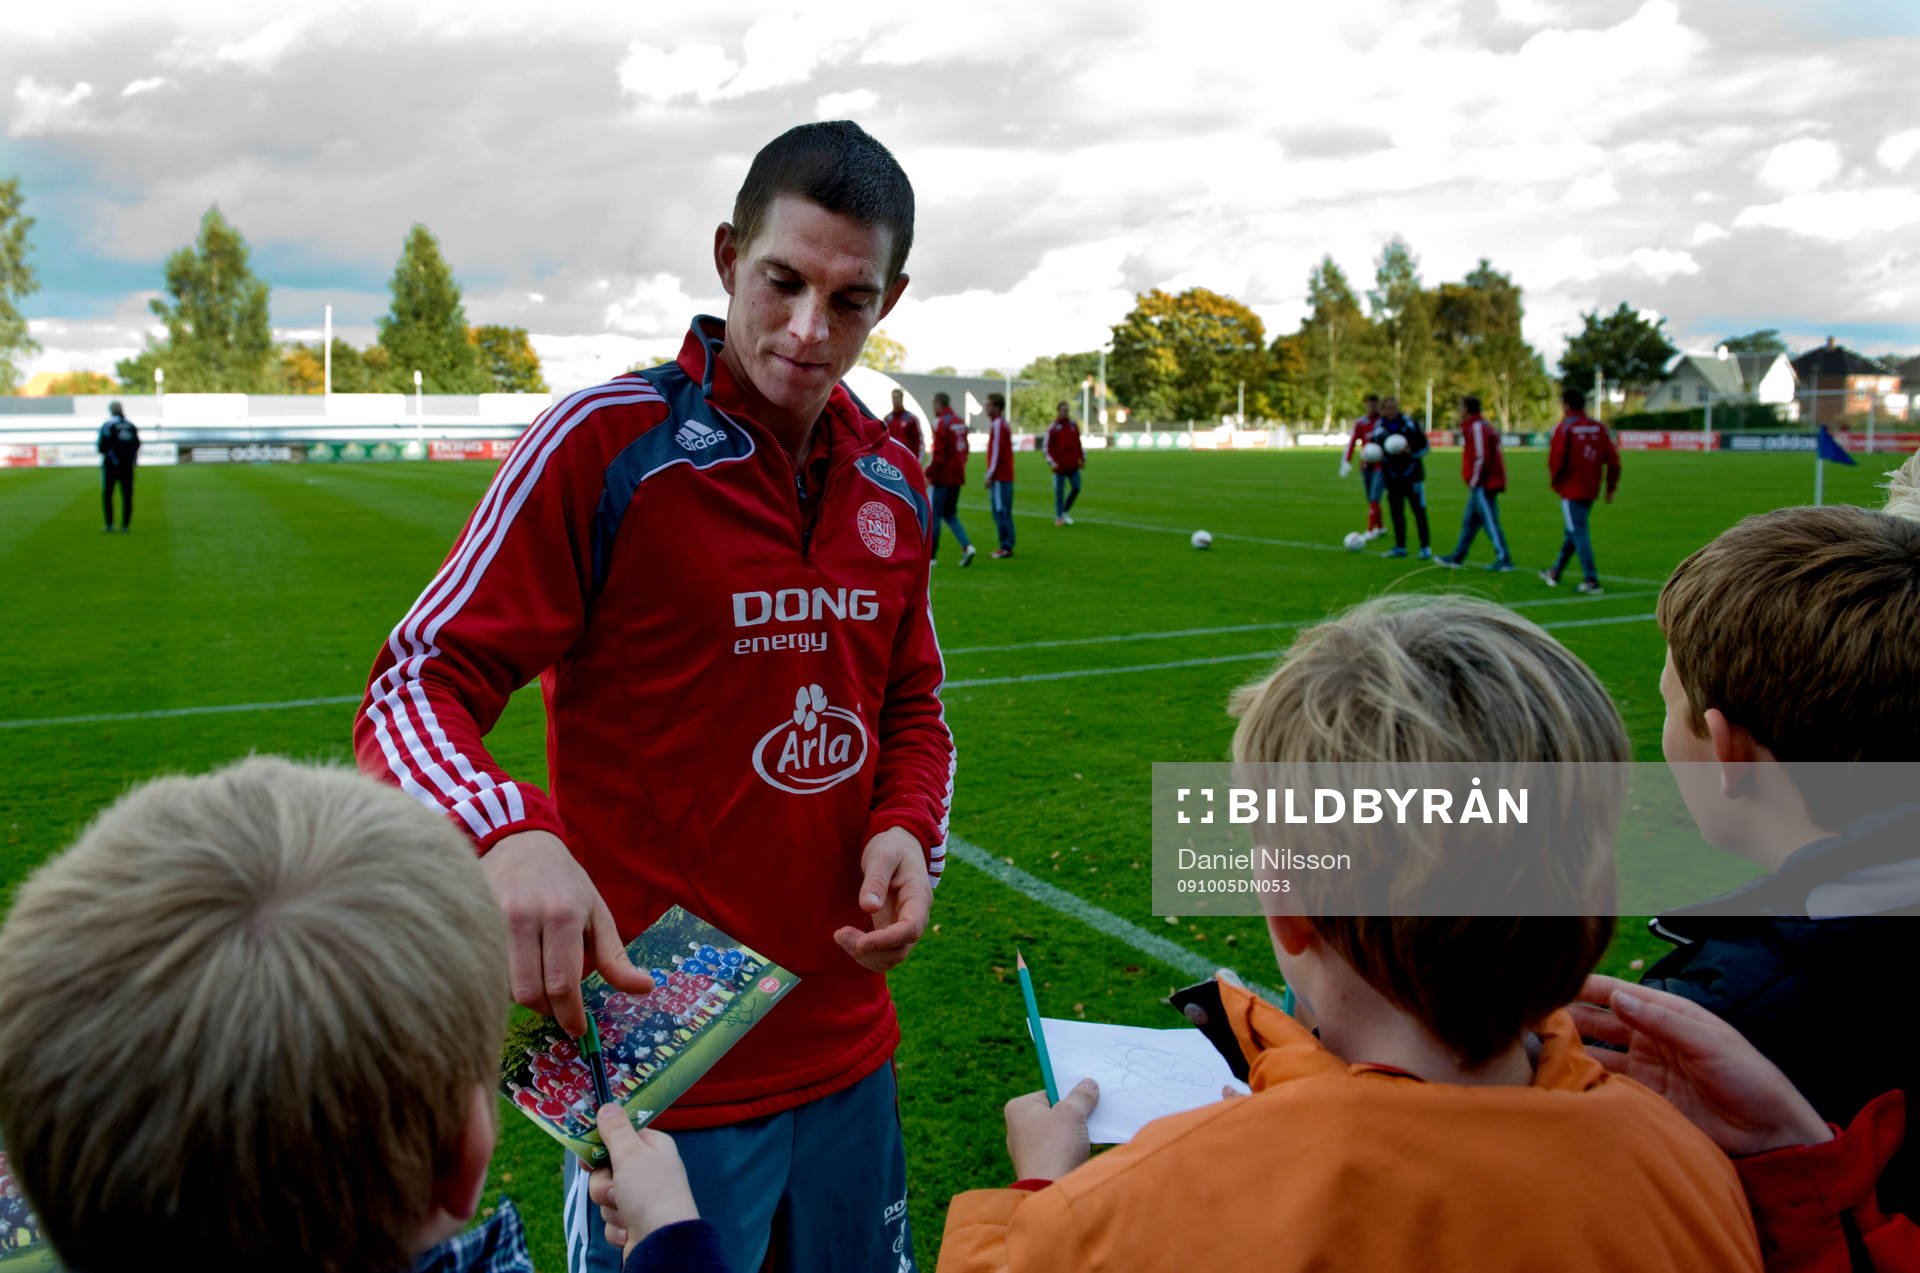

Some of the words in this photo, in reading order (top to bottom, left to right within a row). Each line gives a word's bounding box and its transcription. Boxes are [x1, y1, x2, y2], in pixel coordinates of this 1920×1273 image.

[1765, 433, 1818, 449] adidas
[231, 443, 291, 461] adidas
[875, 463, 898, 478] Arla
[732, 587, 880, 627] DONG
[734, 631, 828, 654] energy
[776, 723, 852, 774] Arla
